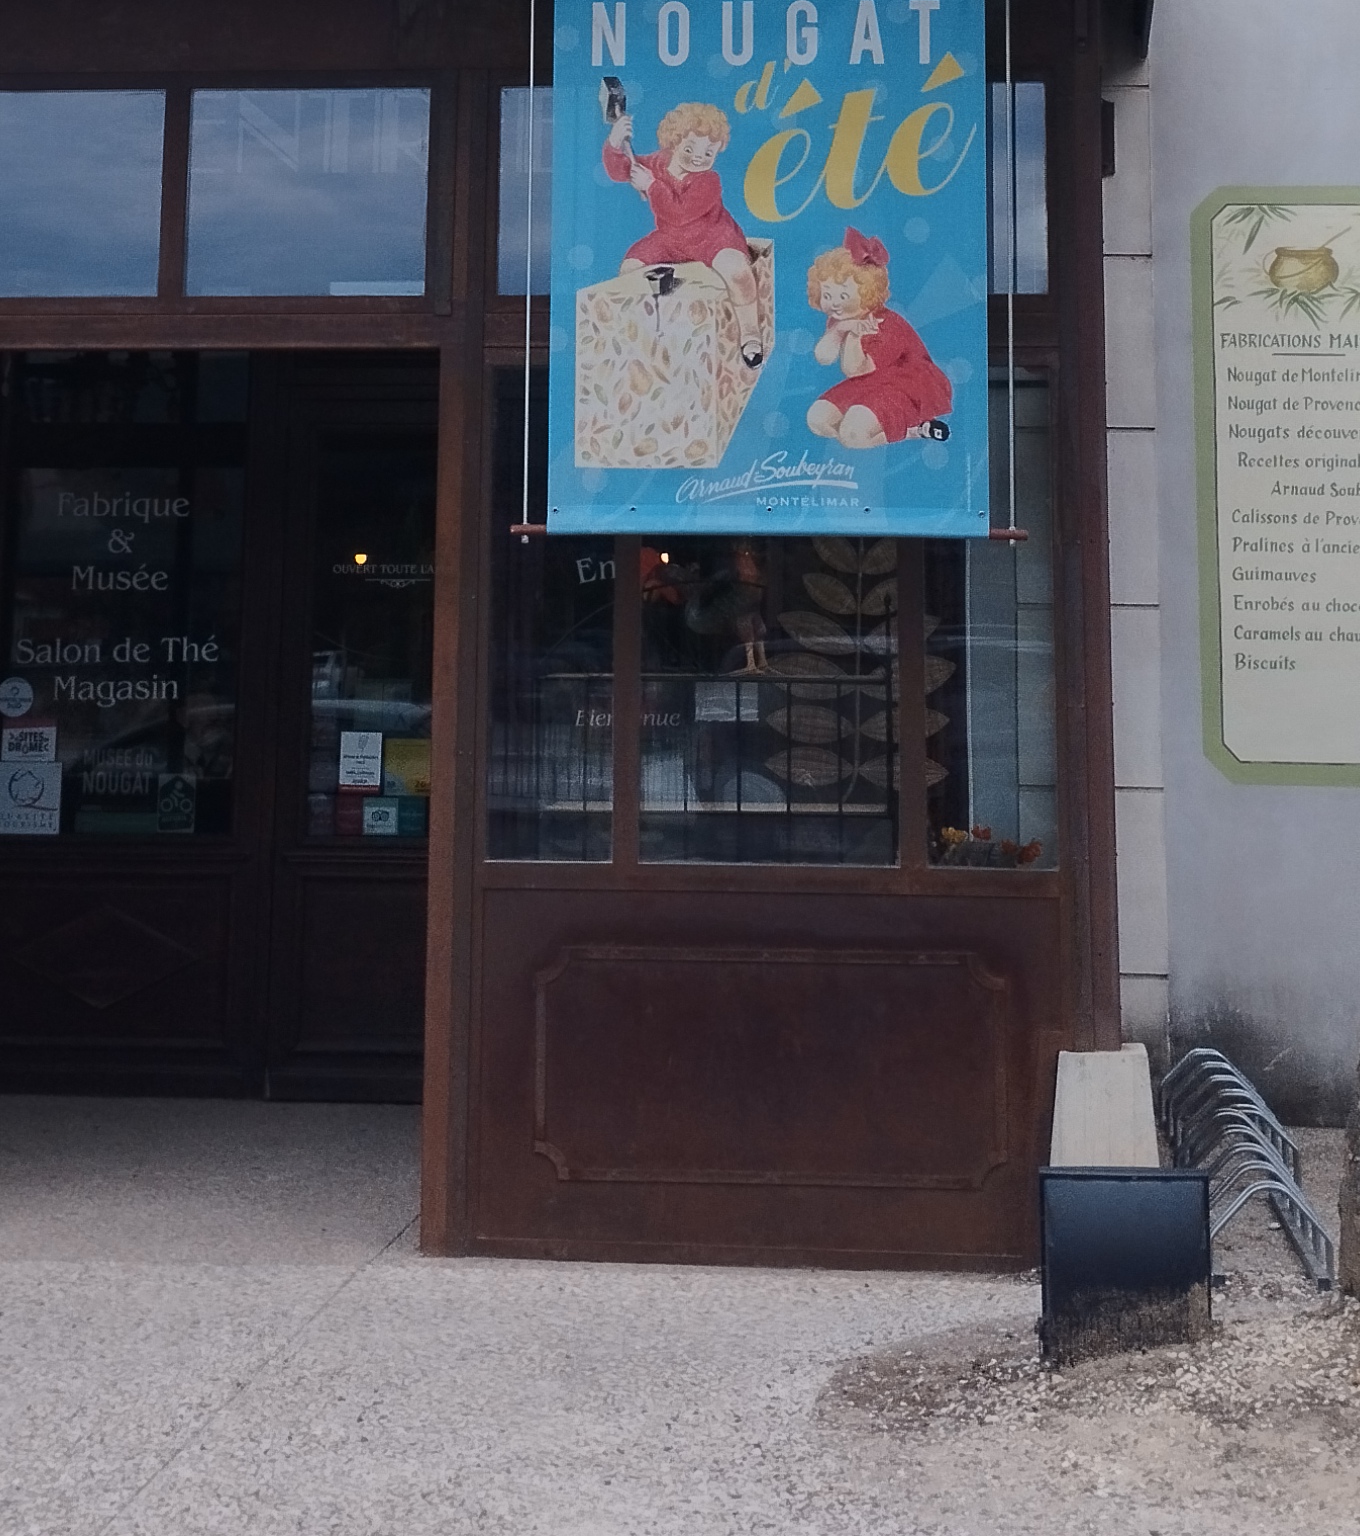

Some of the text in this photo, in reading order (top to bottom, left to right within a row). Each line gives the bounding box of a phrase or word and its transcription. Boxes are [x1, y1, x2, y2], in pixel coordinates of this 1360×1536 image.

[733, 58, 792, 114] d'
[742, 51, 978, 223] été
[1220, 332, 1321, 349] FABRICATIONS
[1227, 366, 1277, 386] Nougat
[1282, 368, 1298, 383] de
[1228, 396, 1278, 416] Nougat
[1283, 397, 1299, 411] de
[1229, 423, 1290, 443] Nougats
[1238, 451, 1299, 469] Recettes
[1271, 480, 1325, 496] Arnaud
[57, 491, 190, 523] Fabrique
[1232, 508, 1298, 525] Calissons
[1303, 512, 1320, 524] de
[107, 528, 136, 554] &
[1233, 537, 1294, 554] Pralines
[1301, 538, 1310, 553] à
[71, 563, 169, 592] Musée
[380, 563, 417, 574] TOUTE
[1232, 566, 1317, 582] Guimauves
[1233, 594, 1295, 611] Enrobés
[1301, 600, 1321, 612] au
[1234, 624, 1301, 642] Caramels
[1305, 630, 1323, 642] au
[16, 635, 219, 665] Salon de Thé
[1235, 652, 1296, 671] Biscuits
[53, 674, 179, 708] Magasin
[82, 770, 152, 795] NOUGAT
